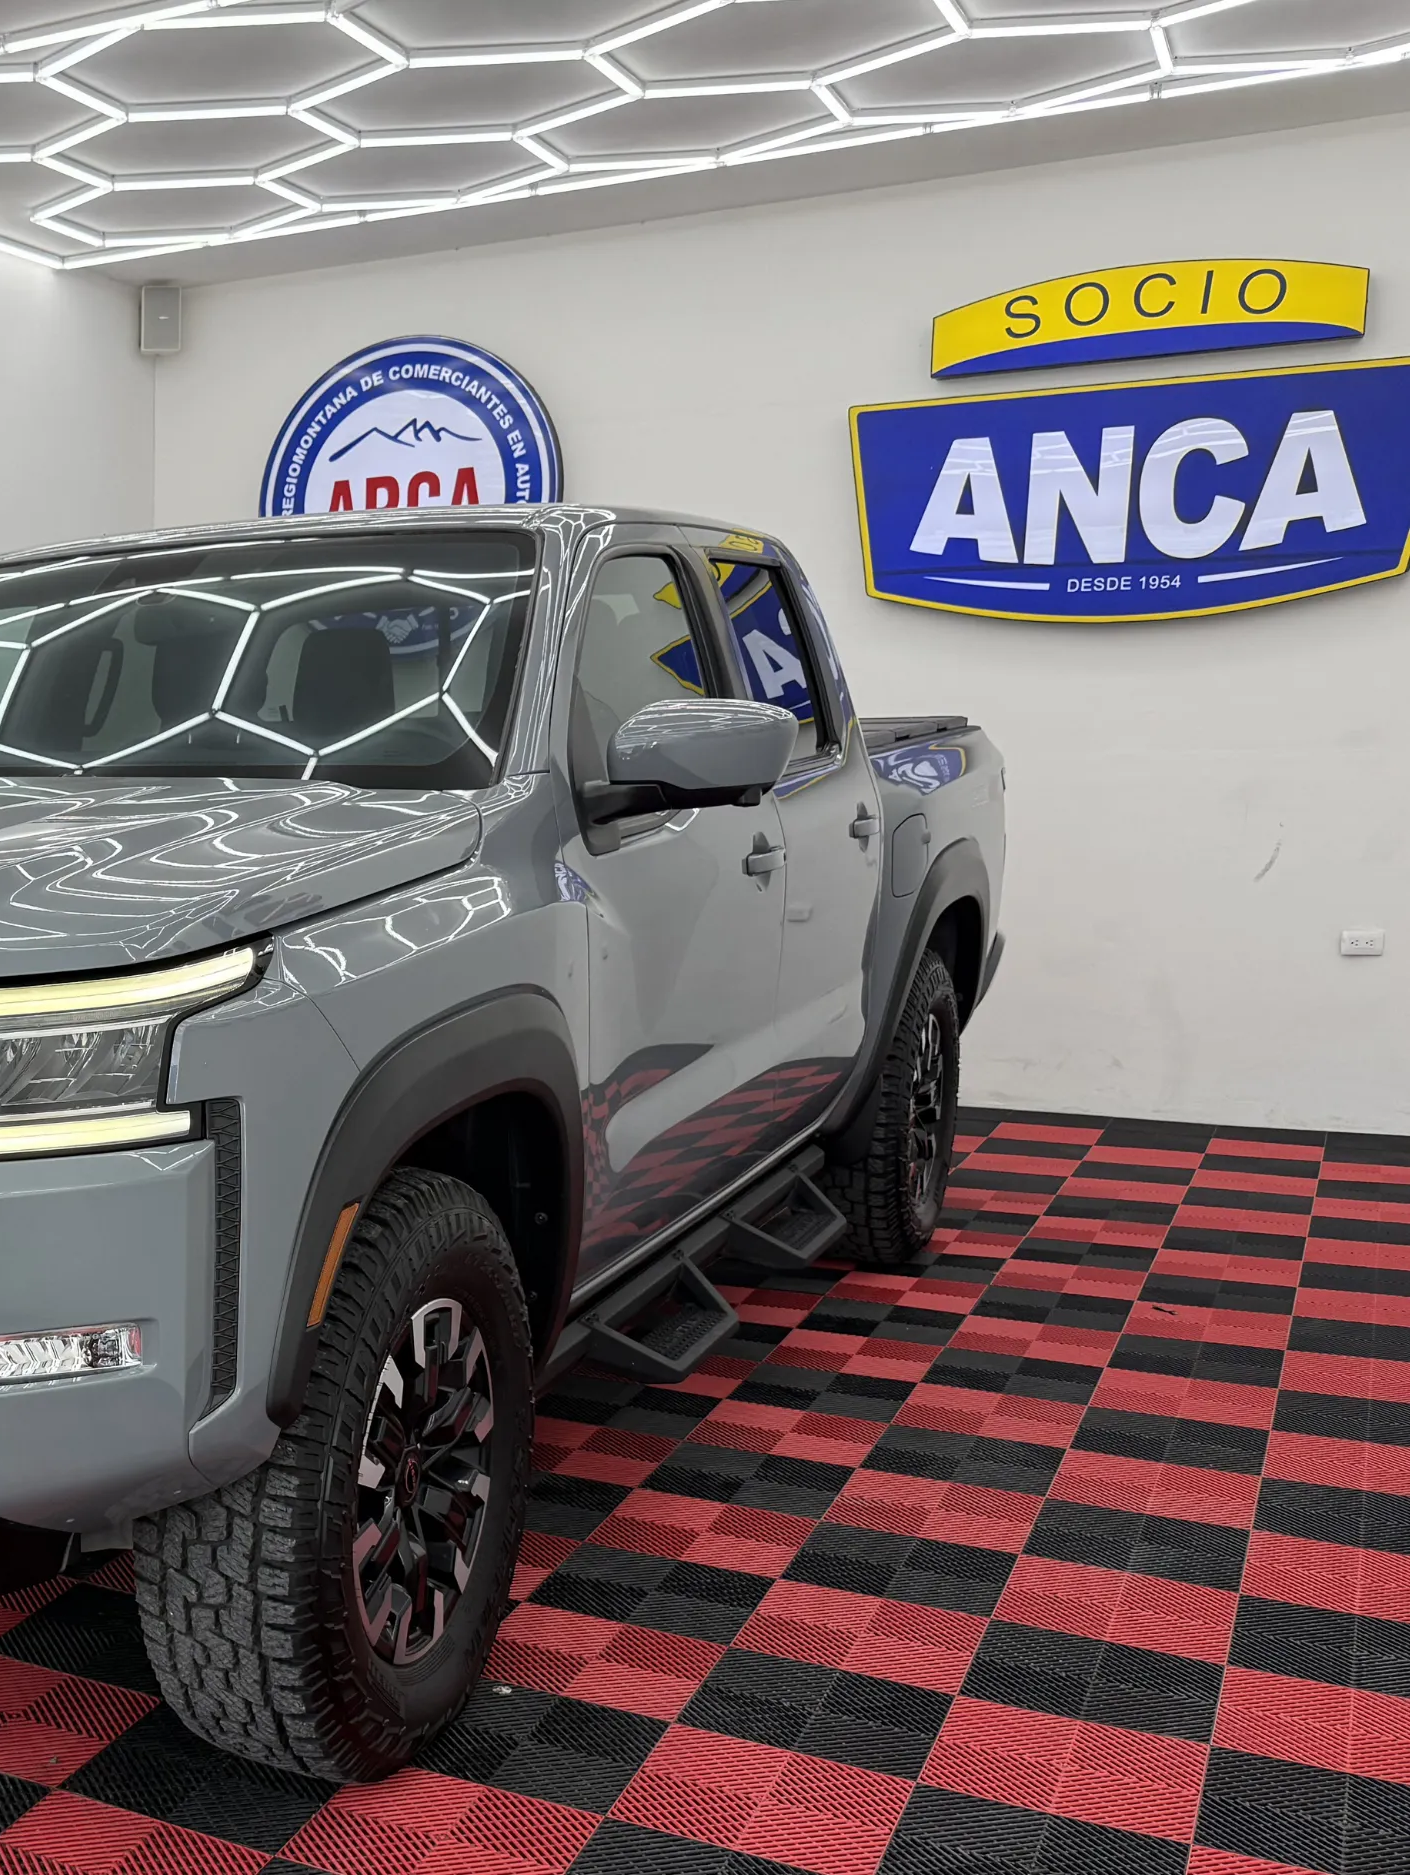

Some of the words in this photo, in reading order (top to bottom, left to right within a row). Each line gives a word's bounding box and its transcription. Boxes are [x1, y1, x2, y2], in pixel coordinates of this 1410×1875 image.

[1003, 268, 1288, 339] SOCIO
[359, 370, 384, 392] DE
[388, 364, 514, 430] COMERCIANTES
[506, 430, 527, 459] EN
[909, 409, 1367, 566] ANCA
[1066, 576, 1132, 594] DESDE
[1138, 574, 1182, 592] 1954
